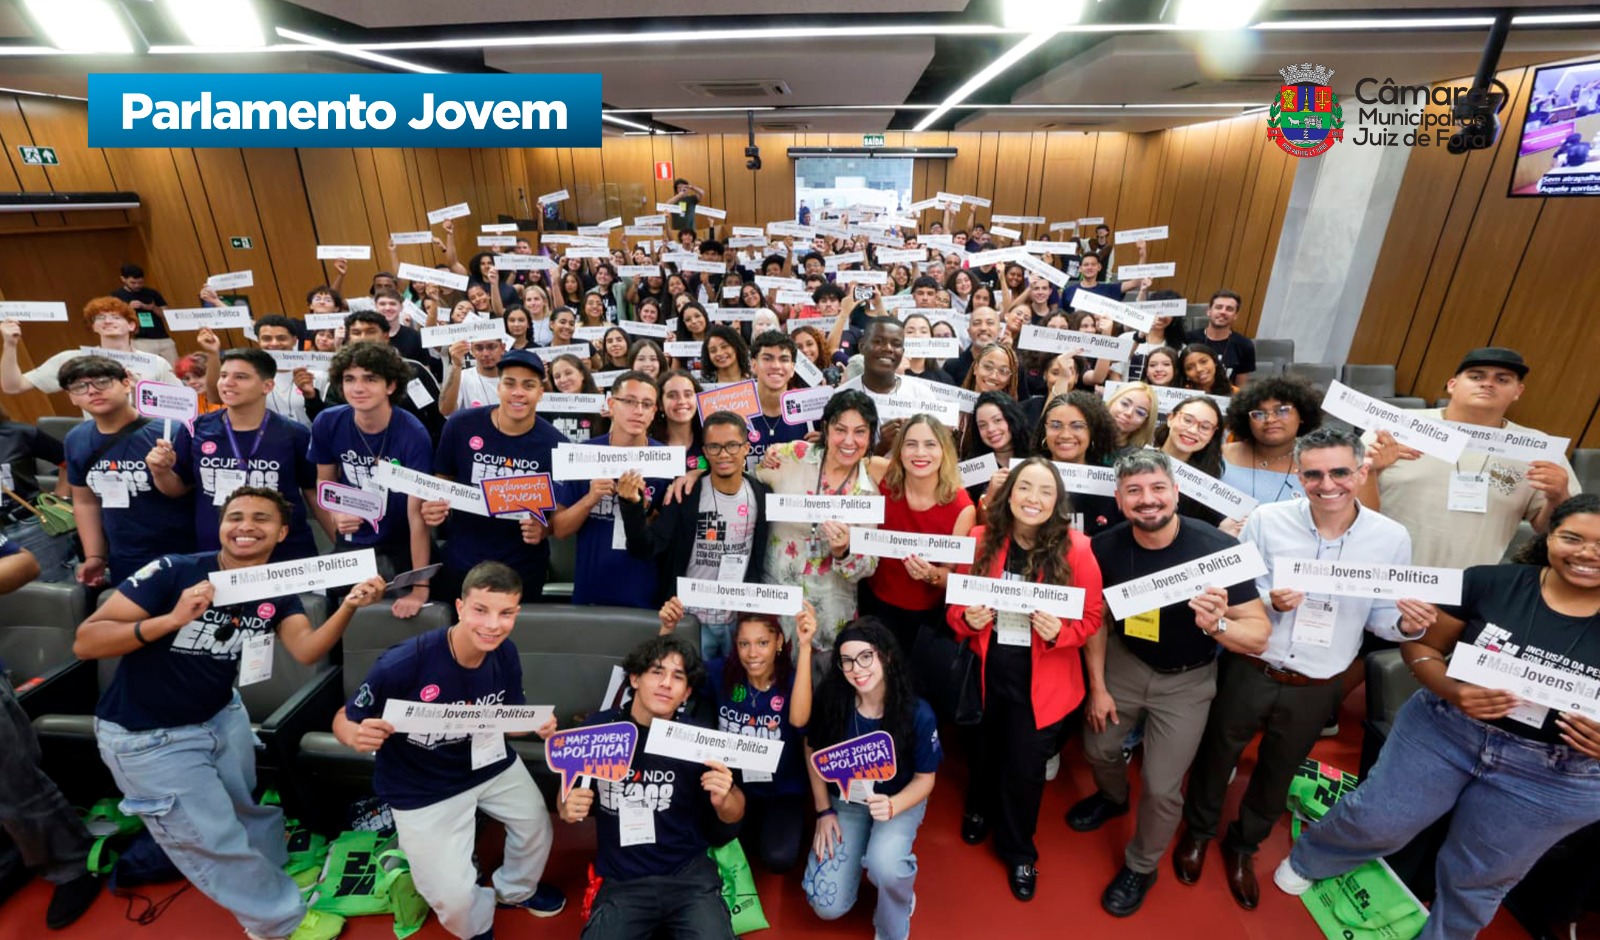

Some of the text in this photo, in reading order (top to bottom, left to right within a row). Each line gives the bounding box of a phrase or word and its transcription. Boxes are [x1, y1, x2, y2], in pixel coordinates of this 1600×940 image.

[864, 136, 884, 146] SAÍDA
[1340, 391, 1449, 443] #MaisJovensNaPolítica
[200, 456, 280, 470] OCUPNDO
[473, 452, 539, 470] OCUPANDO
[568, 450, 671, 464] #MaisJovensNaPolítica
[391, 466, 481, 501] #MaisJovensNaPolítica
[779, 497, 871, 510] #MaisJovensNaPolítica
[864, 531, 961, 550] #MaisJovensNaPolítica
[230, 556, 358, 586] #MaisJovensNaPolítica
[1122, 552, 1242, 598] #MaisJovensNaPolítica
[1293, 562, 1438, 585] #MaisJovensNaPolítica
[690, 583, 789, 600] #MaisJovensNaPolítica
[962, 579, 1068, 602] #MaisJovensNaPolítica
[1571, 661, 1584, 672] DA
[1476, 653, 1600, 701] #MaisJovensNaP
[405, 704, 535, 720] #MaisJovensNaPolítica
[591, 732, 631, 744] JOVENS
[665, 725, 769, 755] #MaisJovensNaPolítica
[851, 739, 886, 756] JOVENS
[626, 769, 675, 782] PANDO
